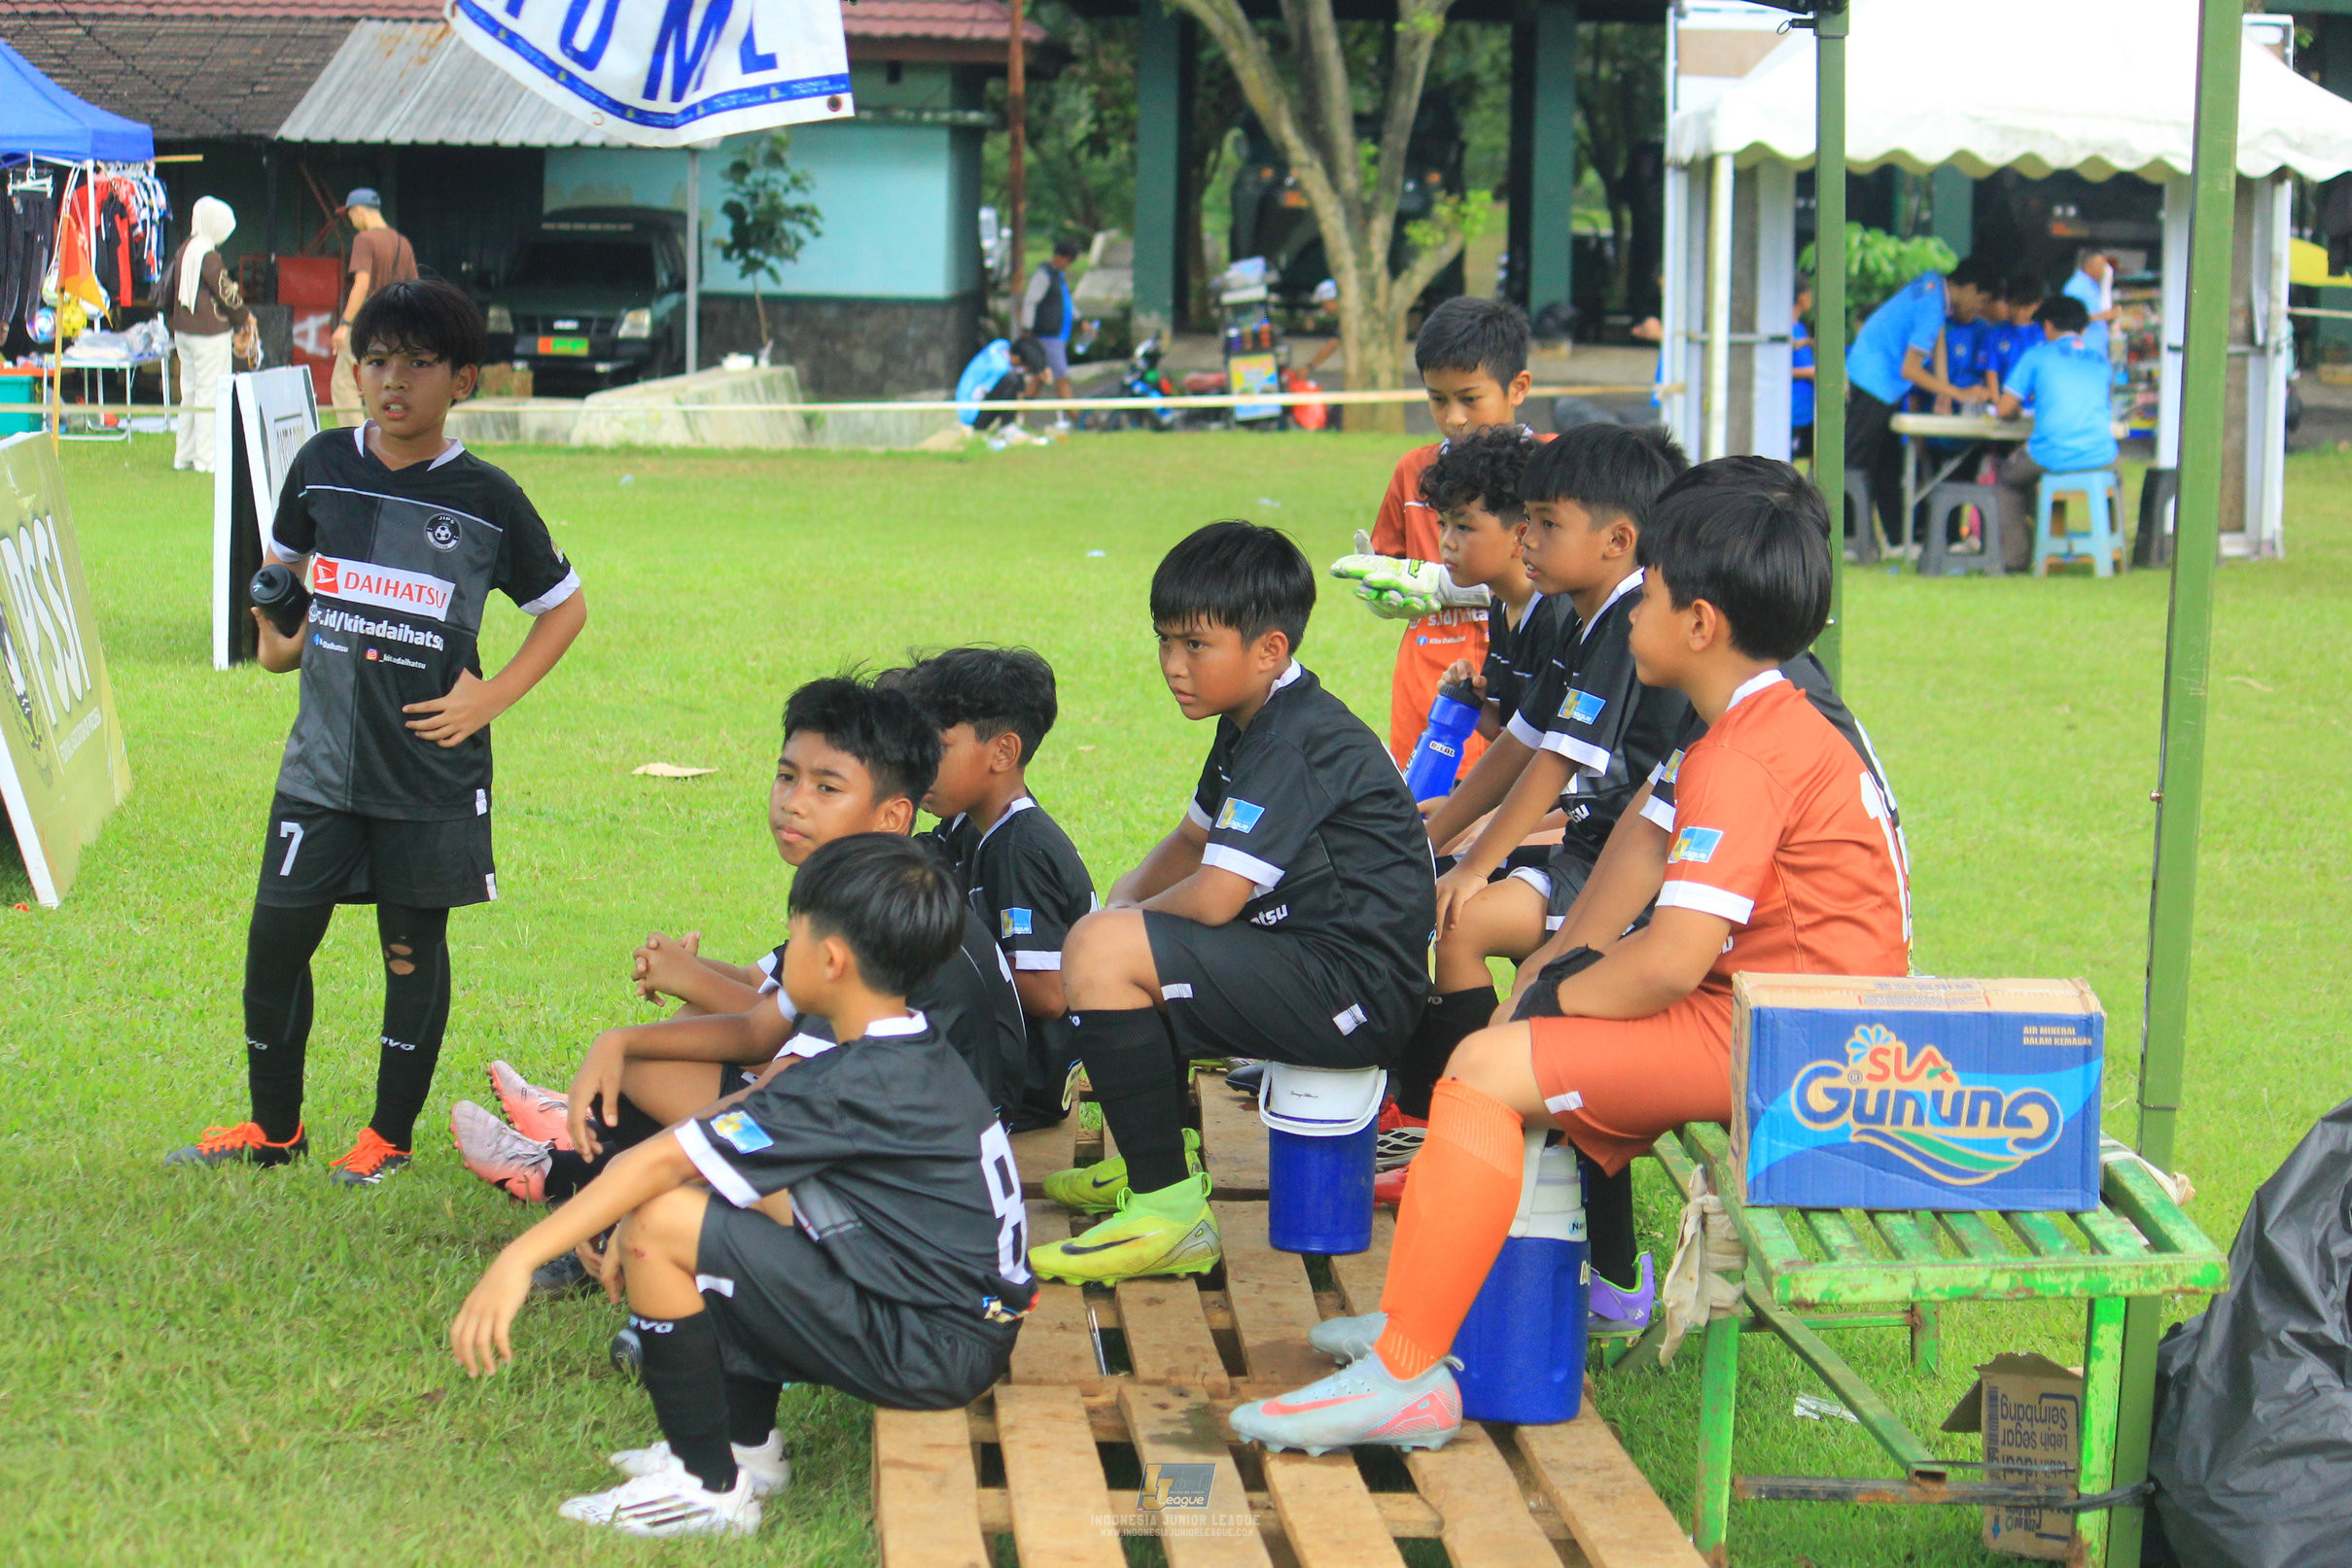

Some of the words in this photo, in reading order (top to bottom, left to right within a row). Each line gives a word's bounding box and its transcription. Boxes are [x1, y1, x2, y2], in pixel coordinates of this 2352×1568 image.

[344, 572, 447, 609] DAIHATSU
[0, 514, 91, 727] PSSI
[279, 821, 304, 877] 7
[2000, 1393, 2068, 1431] Seimbang
[2001, 1422, 2038, 1450] segar
[2040, 1432, 2068, 1451] Lebih
